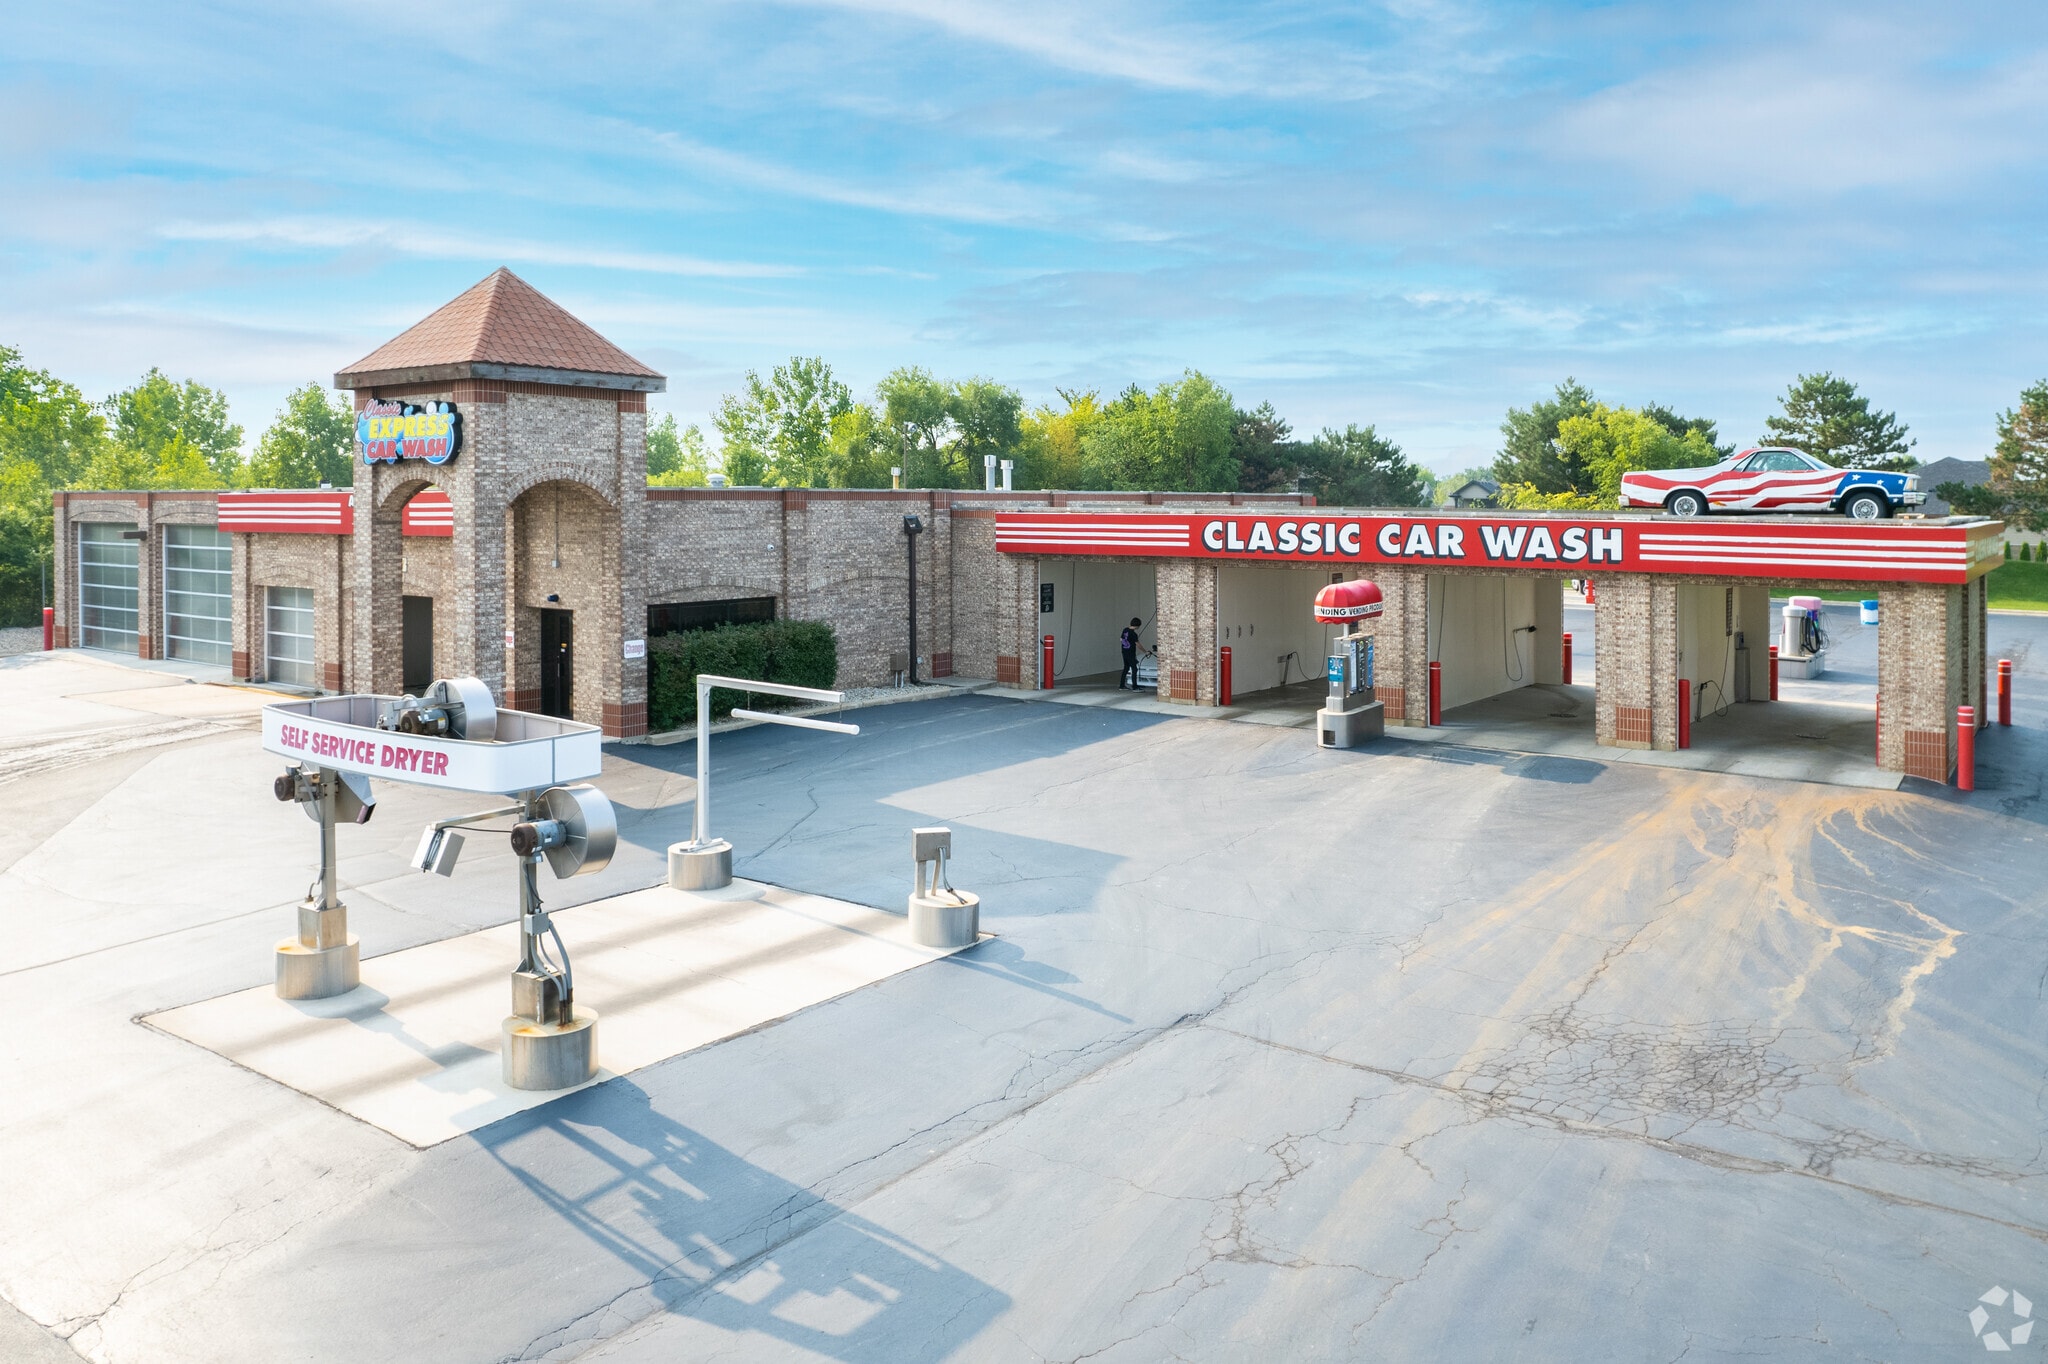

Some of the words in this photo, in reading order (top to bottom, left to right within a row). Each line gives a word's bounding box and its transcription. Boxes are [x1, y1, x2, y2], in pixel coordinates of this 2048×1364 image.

[364, 399, 401, 419] Classic
[368, 414, 450, 439] EXPRESS
[366, 440, 397, 458] CAR
[401, 438, 448, 458] WASH
[1202, 520, 1361, 557] CLASSIC
[1377, 523, 1466, 559] CAR
[1479, 525, 1624, 565] WASH
[281, 724, 309, 750] SELF
[312, 732, 376, 765] SERVICE
[381, 745, 449, 776] DRYER
